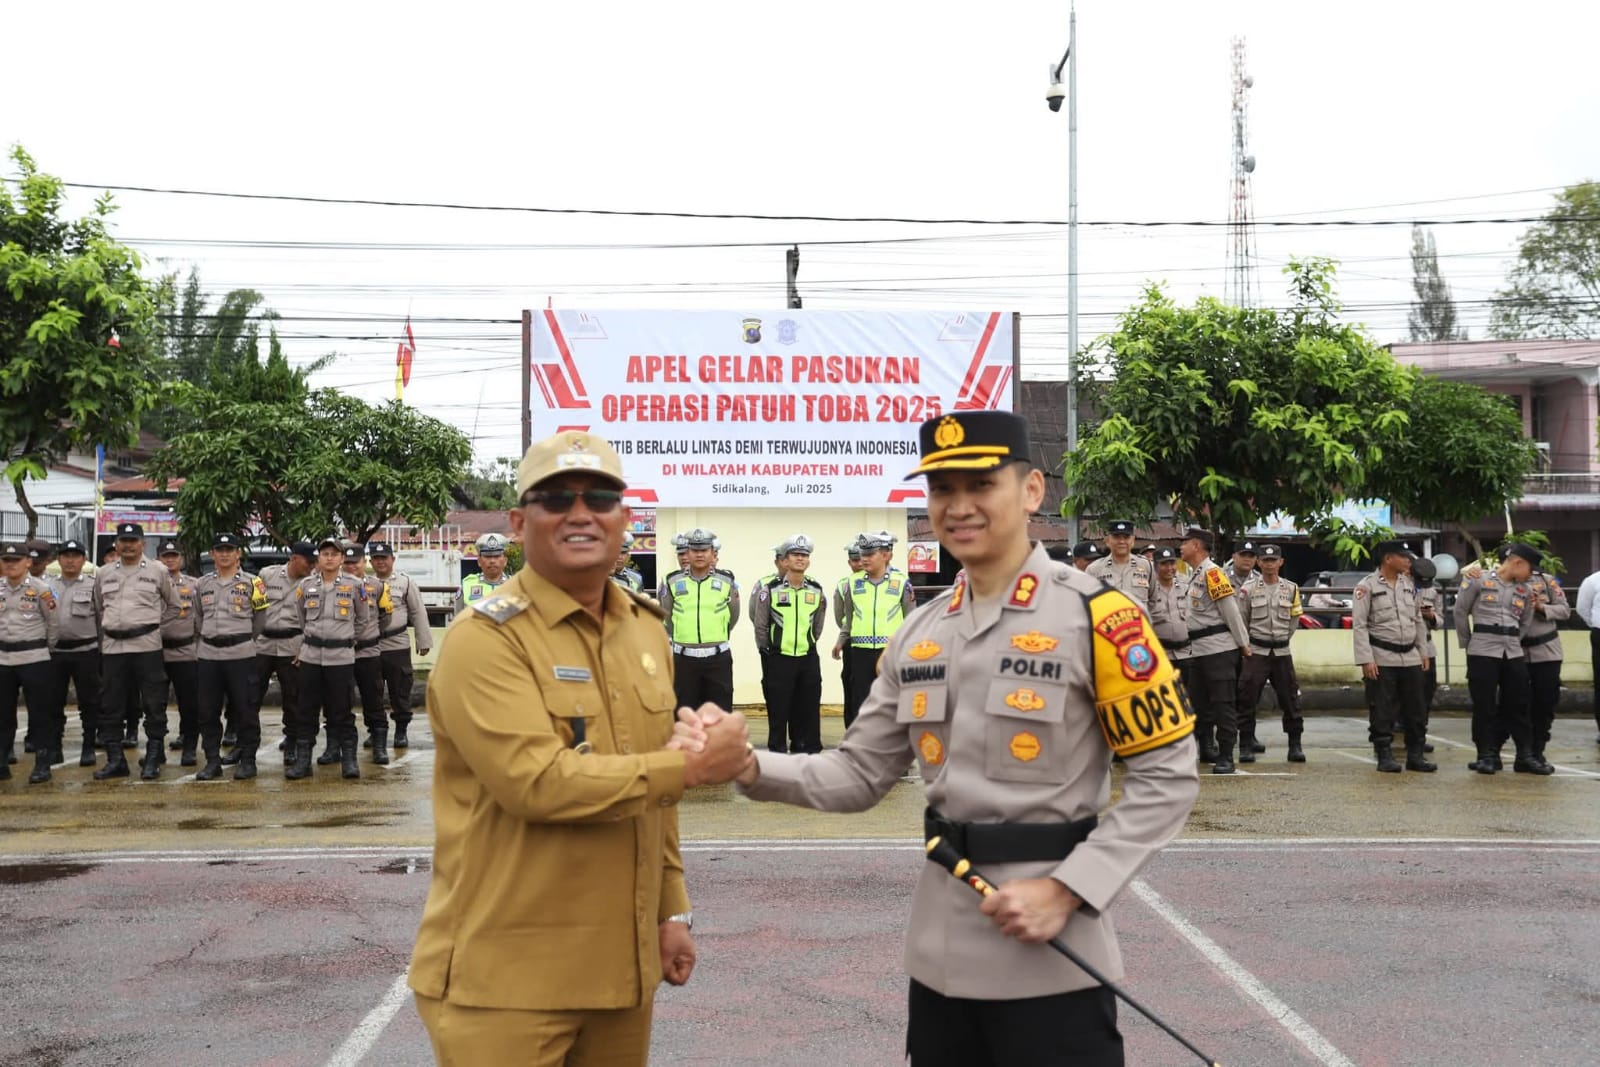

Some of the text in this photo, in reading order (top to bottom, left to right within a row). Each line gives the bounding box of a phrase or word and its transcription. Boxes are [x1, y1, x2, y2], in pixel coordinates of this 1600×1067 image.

[626, 355, 920, 384] APEL GELAR PASUKAN
[602, 394, 942, 422] OPERASI PATUH TOBA 2025
[607, 440, 918, 455] TIB BERLALU LINTAS DEMI TERWUJUDNYA INDONESIA
[662, 464, 883, 476] DI WILAYAH KABUPATEN DAIRI
[712, 484, 832, 495] Sidikalang, Juli 2025
[1000, 657, 1062, 680] POLRI
[1130, 684, 1181, 737] OPS
